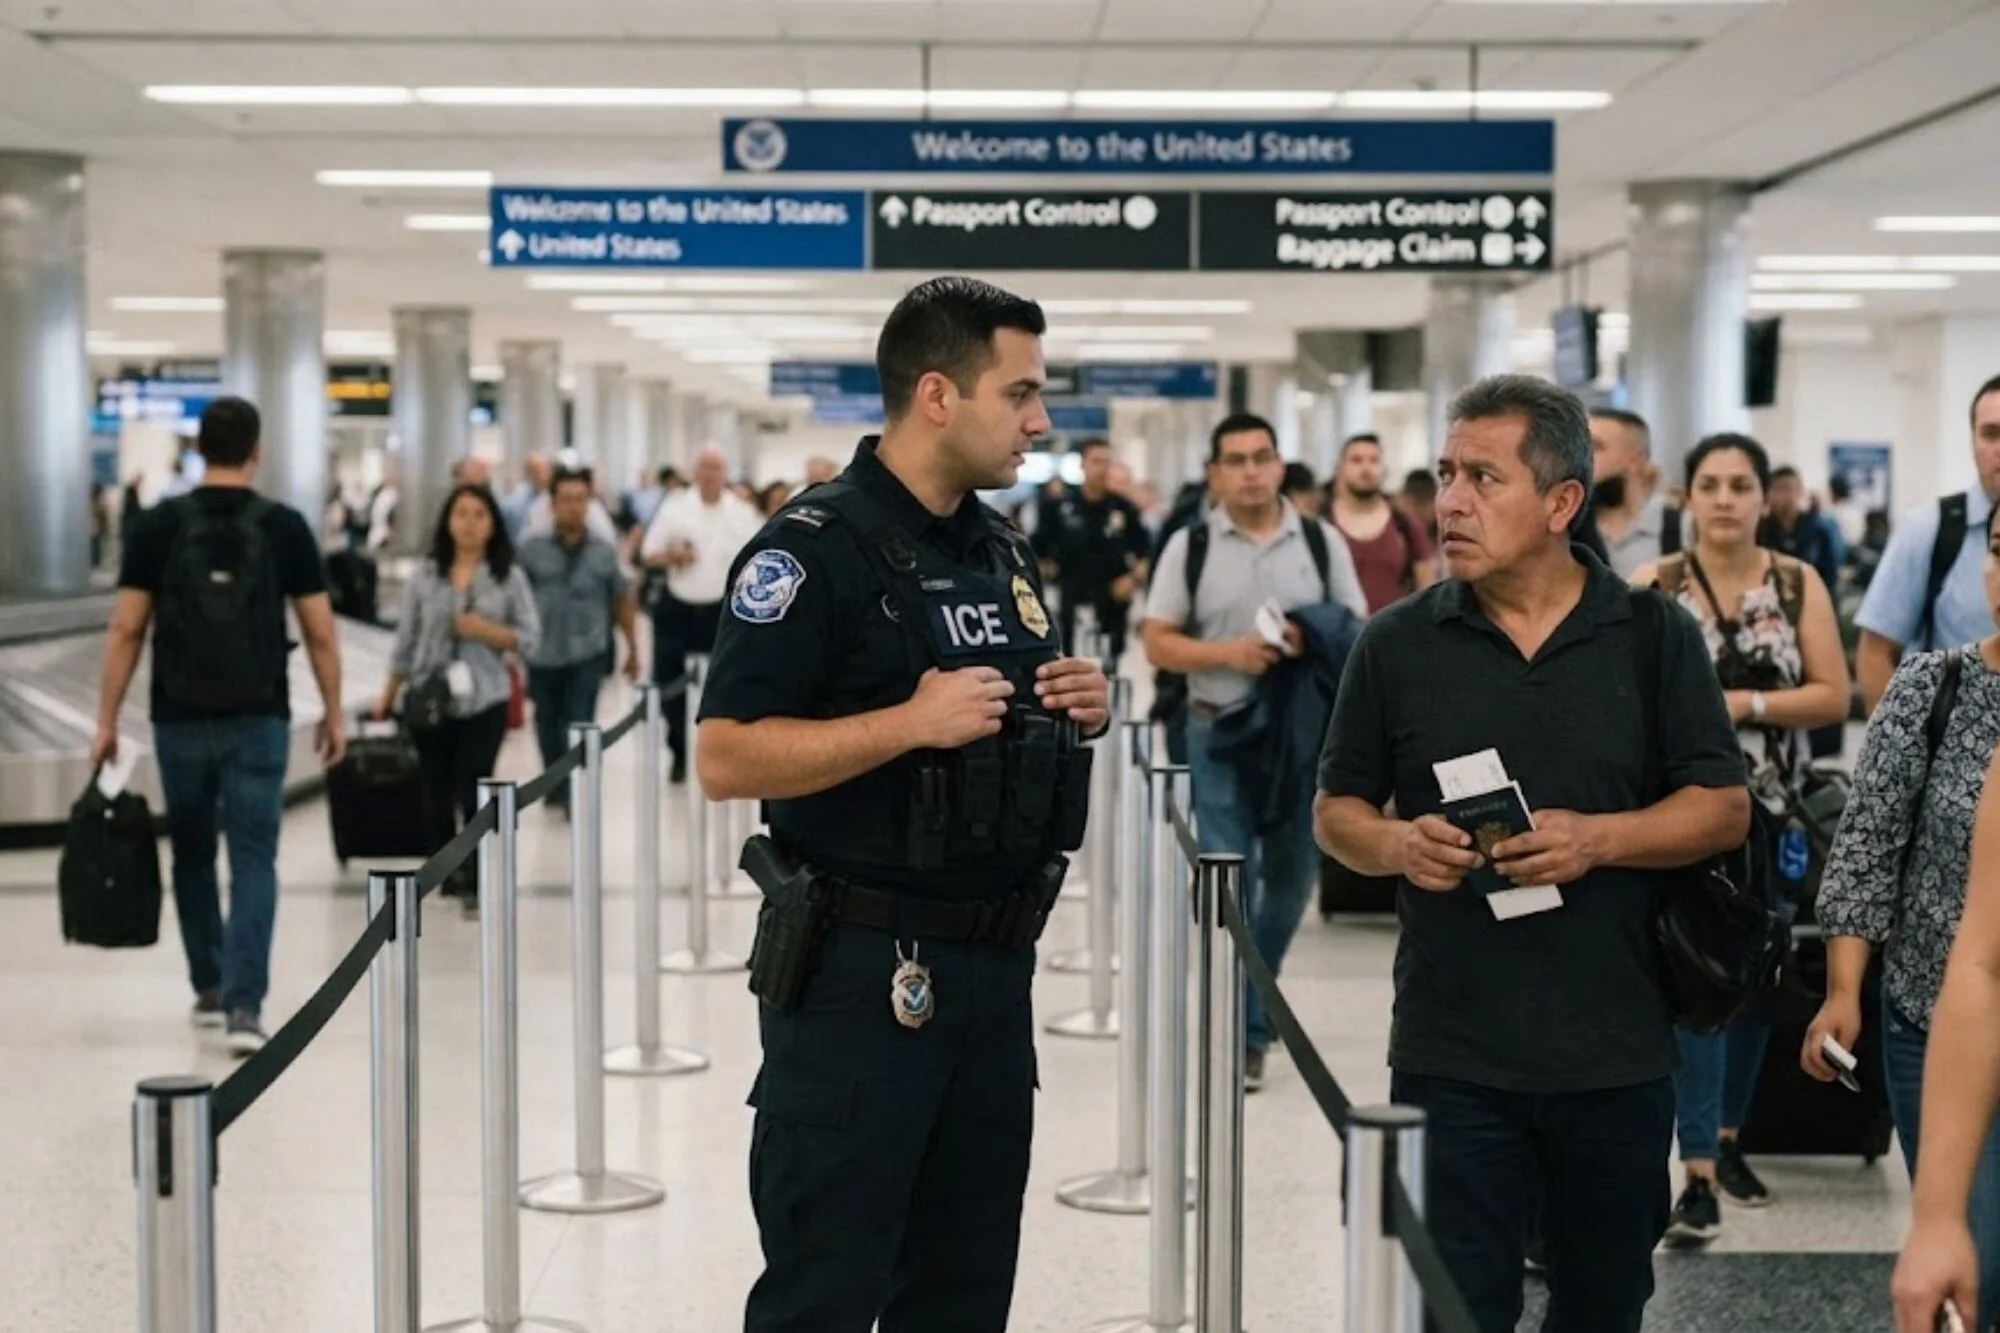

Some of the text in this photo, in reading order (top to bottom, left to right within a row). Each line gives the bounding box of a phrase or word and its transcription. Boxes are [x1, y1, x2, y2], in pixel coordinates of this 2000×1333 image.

[912, 129, 1352, 162] Welcome to the United States
[502, 194, 849, 225] Welcome to the United States
[912, 196, 1121, 232] Passport Control
[1276, 197, 1481, 231] Passport Control
[528, 232, 683, 260] United States
[1277, 231, 1476, 269] Baggage Claim
[940, 603, 1010, 646] ICE
